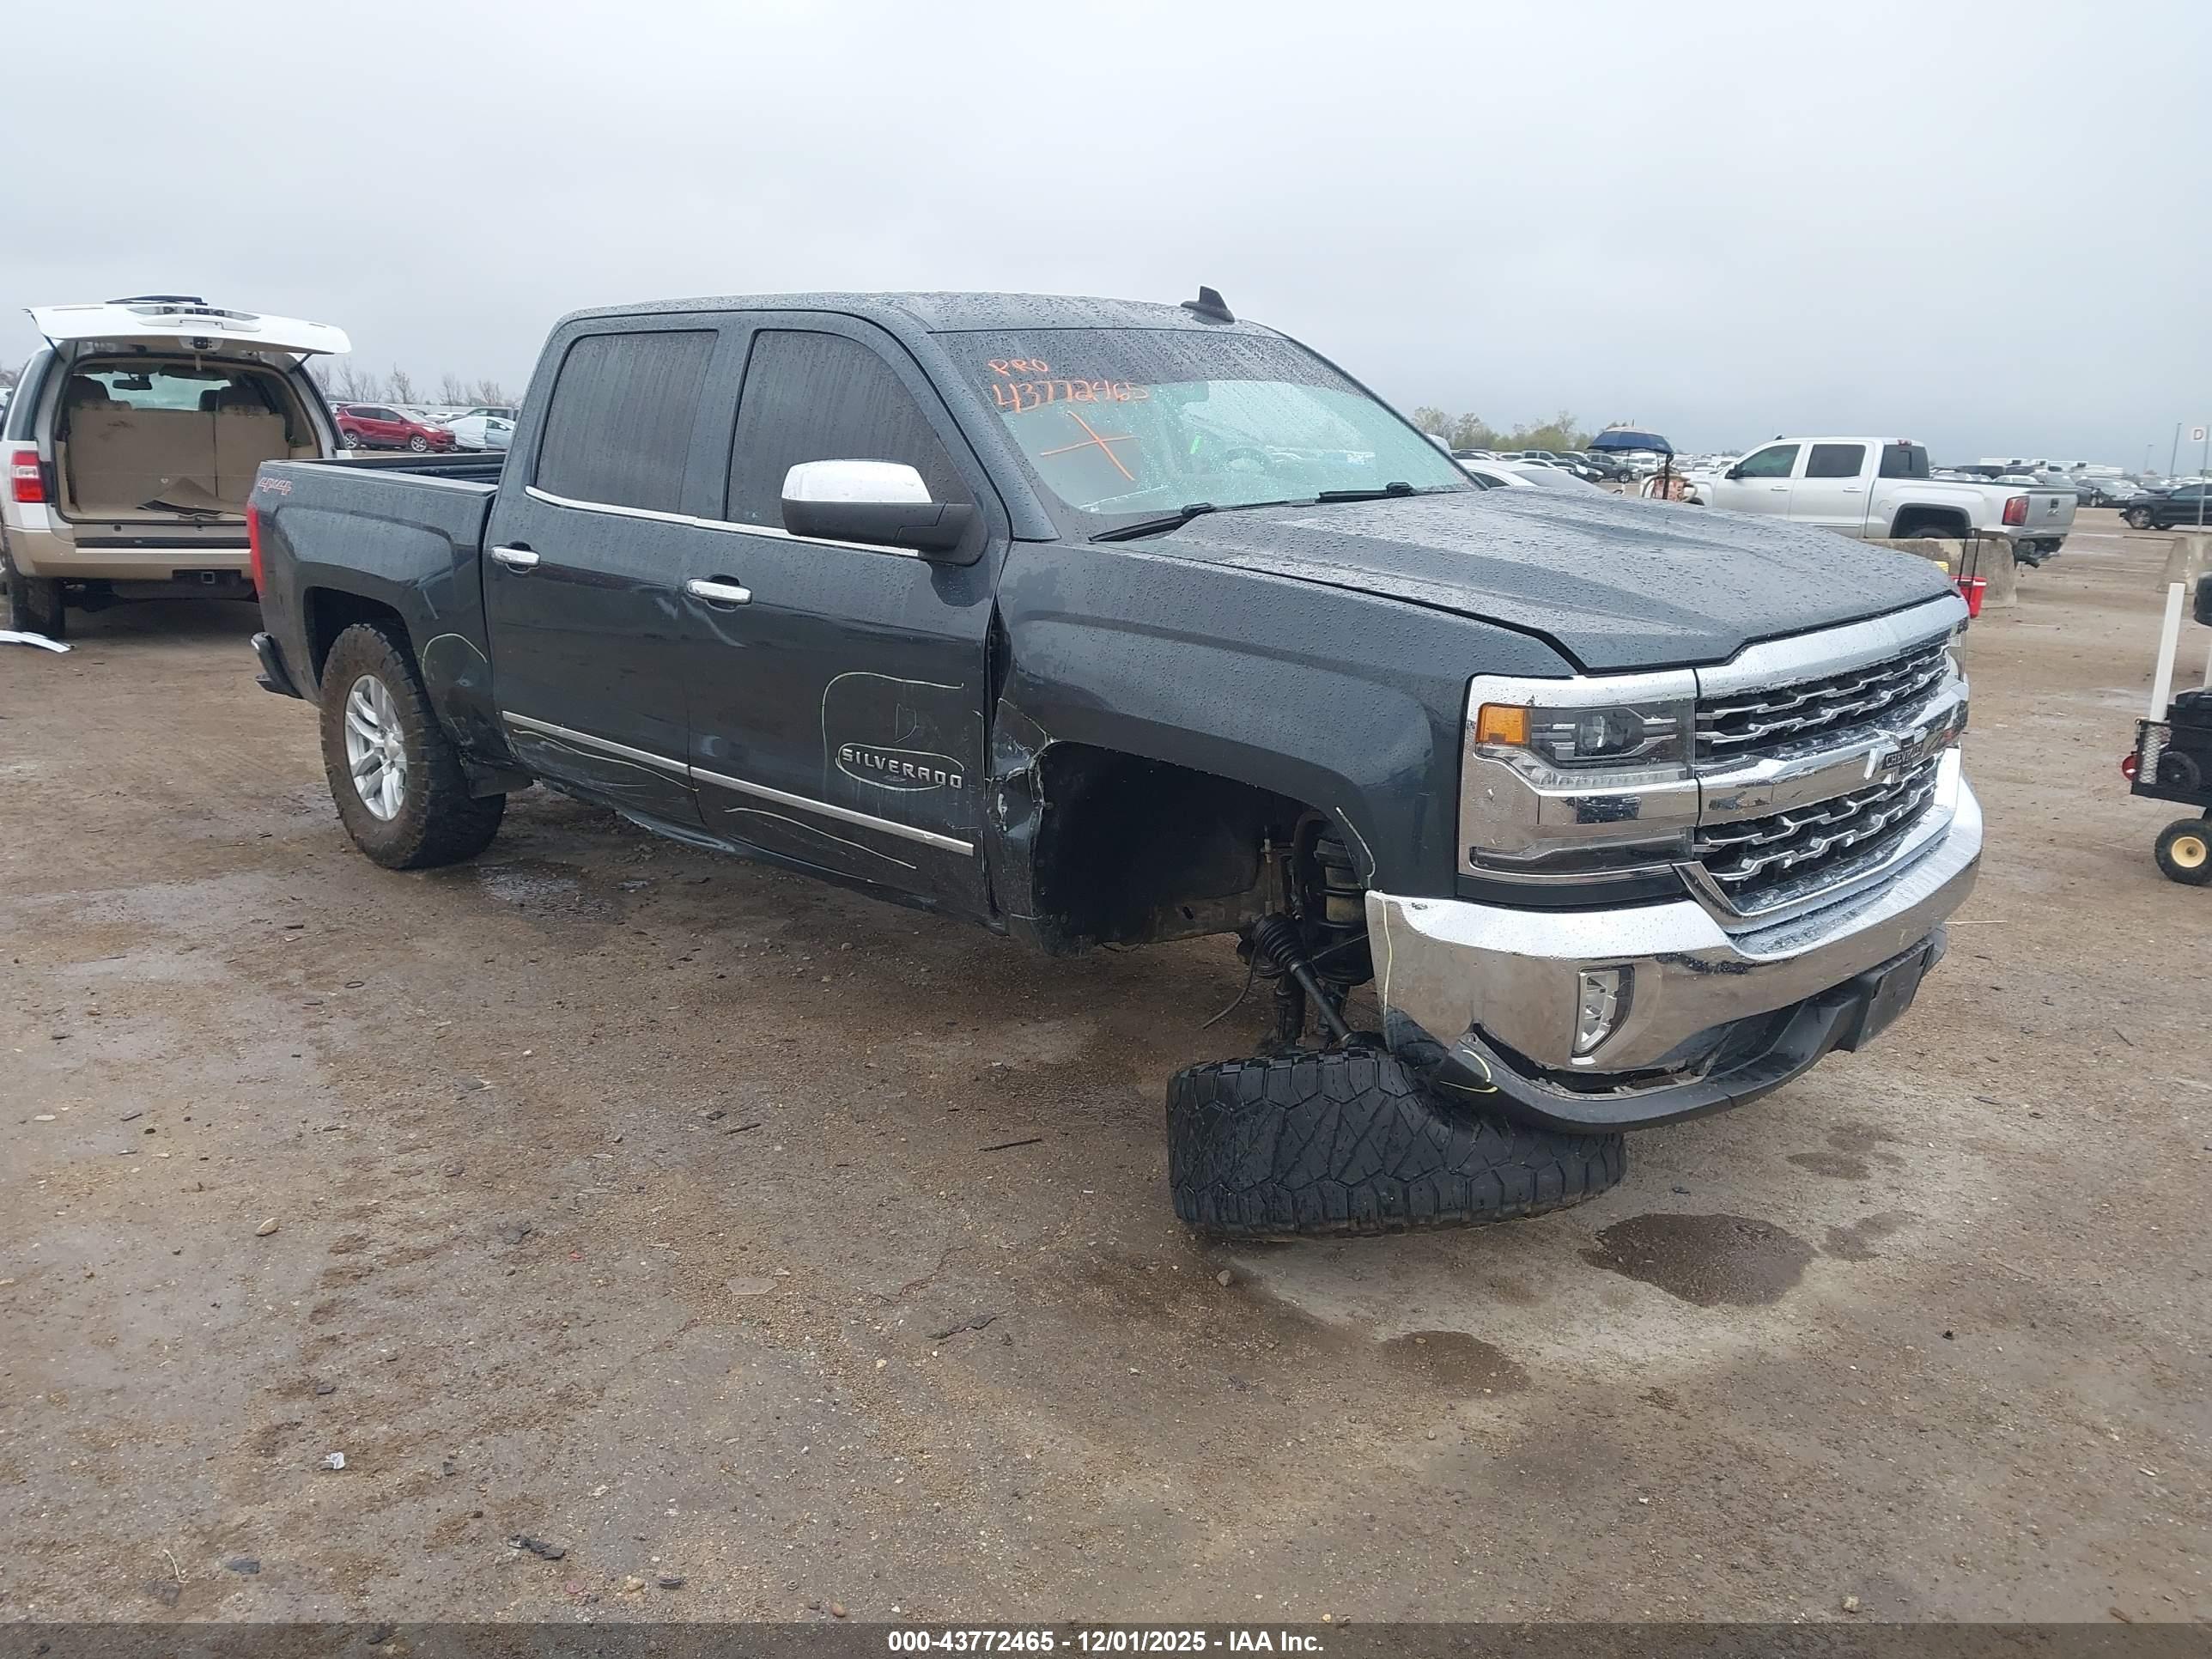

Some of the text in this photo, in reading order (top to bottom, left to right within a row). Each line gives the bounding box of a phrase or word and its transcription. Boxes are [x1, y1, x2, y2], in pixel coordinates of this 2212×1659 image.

[993, 380, 1149, 413] 43772465
[2193, 428, 2204, 441] D
[842, 748, 963, 789] SILVERADO
